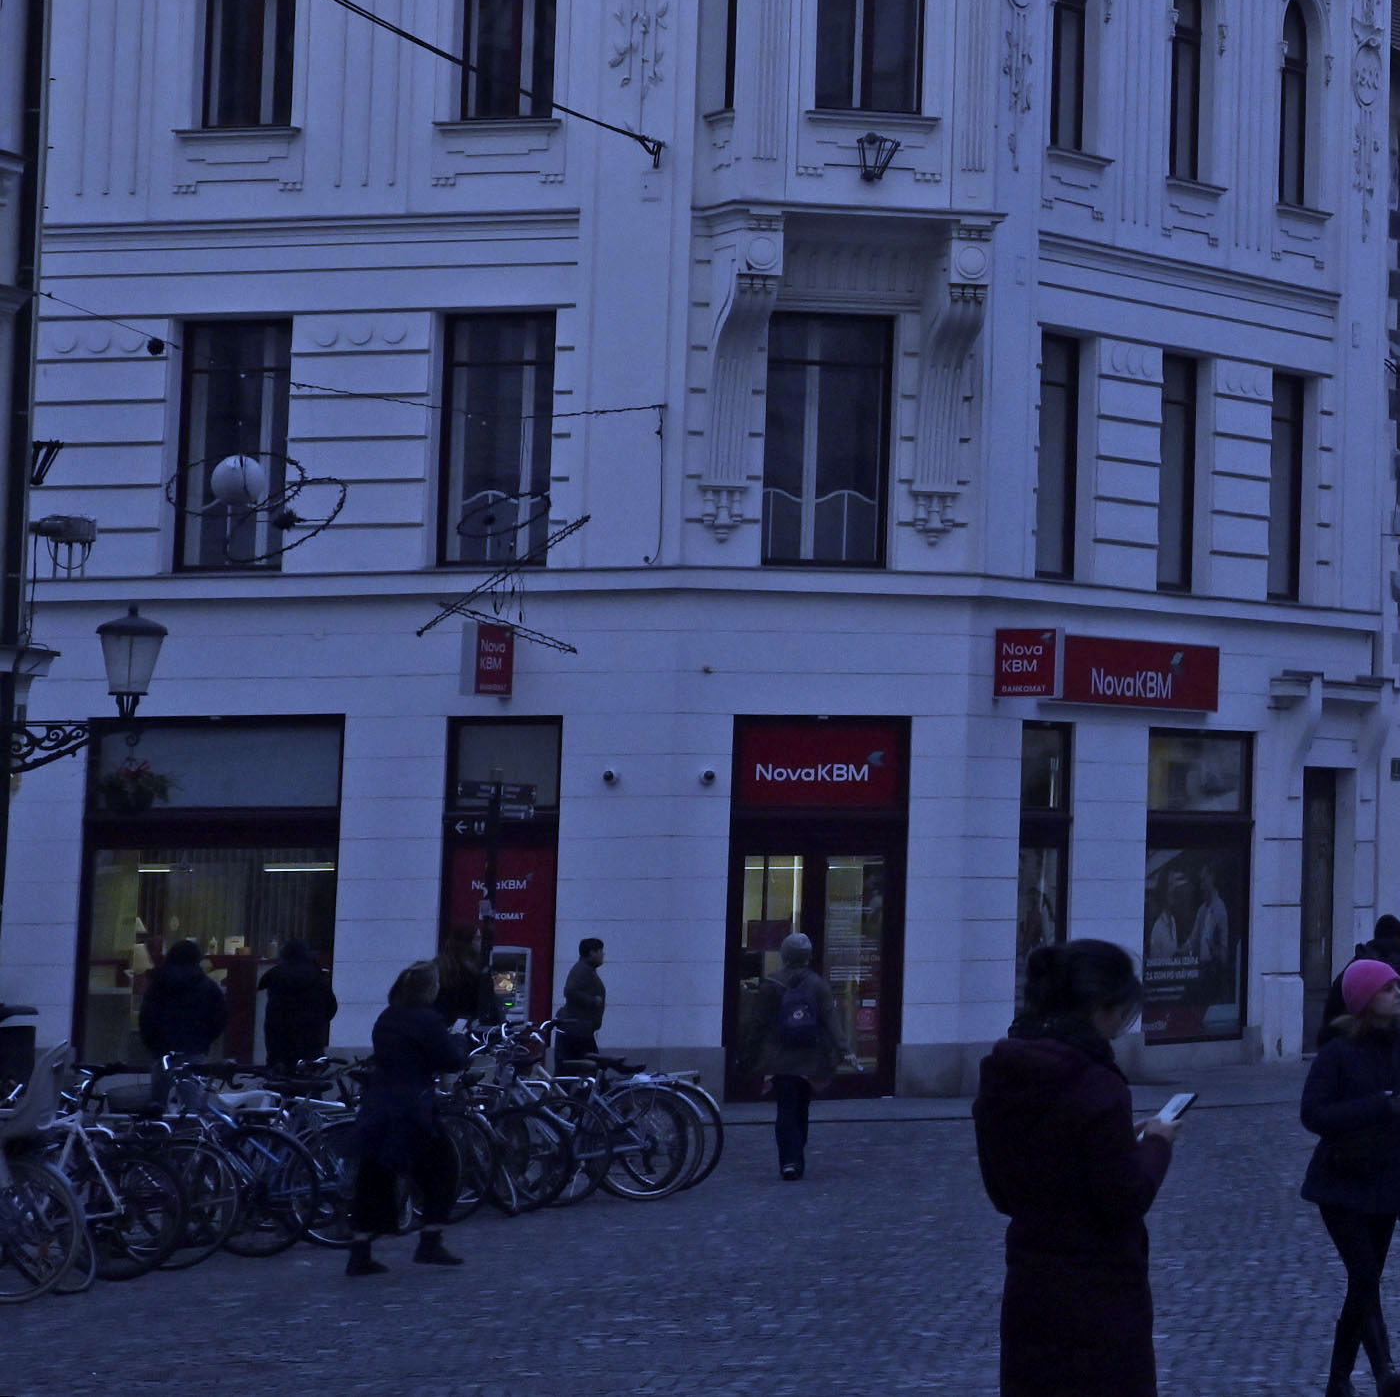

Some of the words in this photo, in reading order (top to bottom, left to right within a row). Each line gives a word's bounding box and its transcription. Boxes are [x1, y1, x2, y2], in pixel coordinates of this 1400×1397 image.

[480, 639, 506, 653] Nova
[1002, 642, 1043, 656] Nova
[1001, 659, 1038, 673] KBM
[1001, 684, 1046, 693] BANKOMAT
[1091, 667, 1172, 699] NovaKBM
[755, 763, 869, 782] NovaKBM
[472, 880, 527, 891] NoaKBM
[479, 912, 525, 921] BKOMAT
